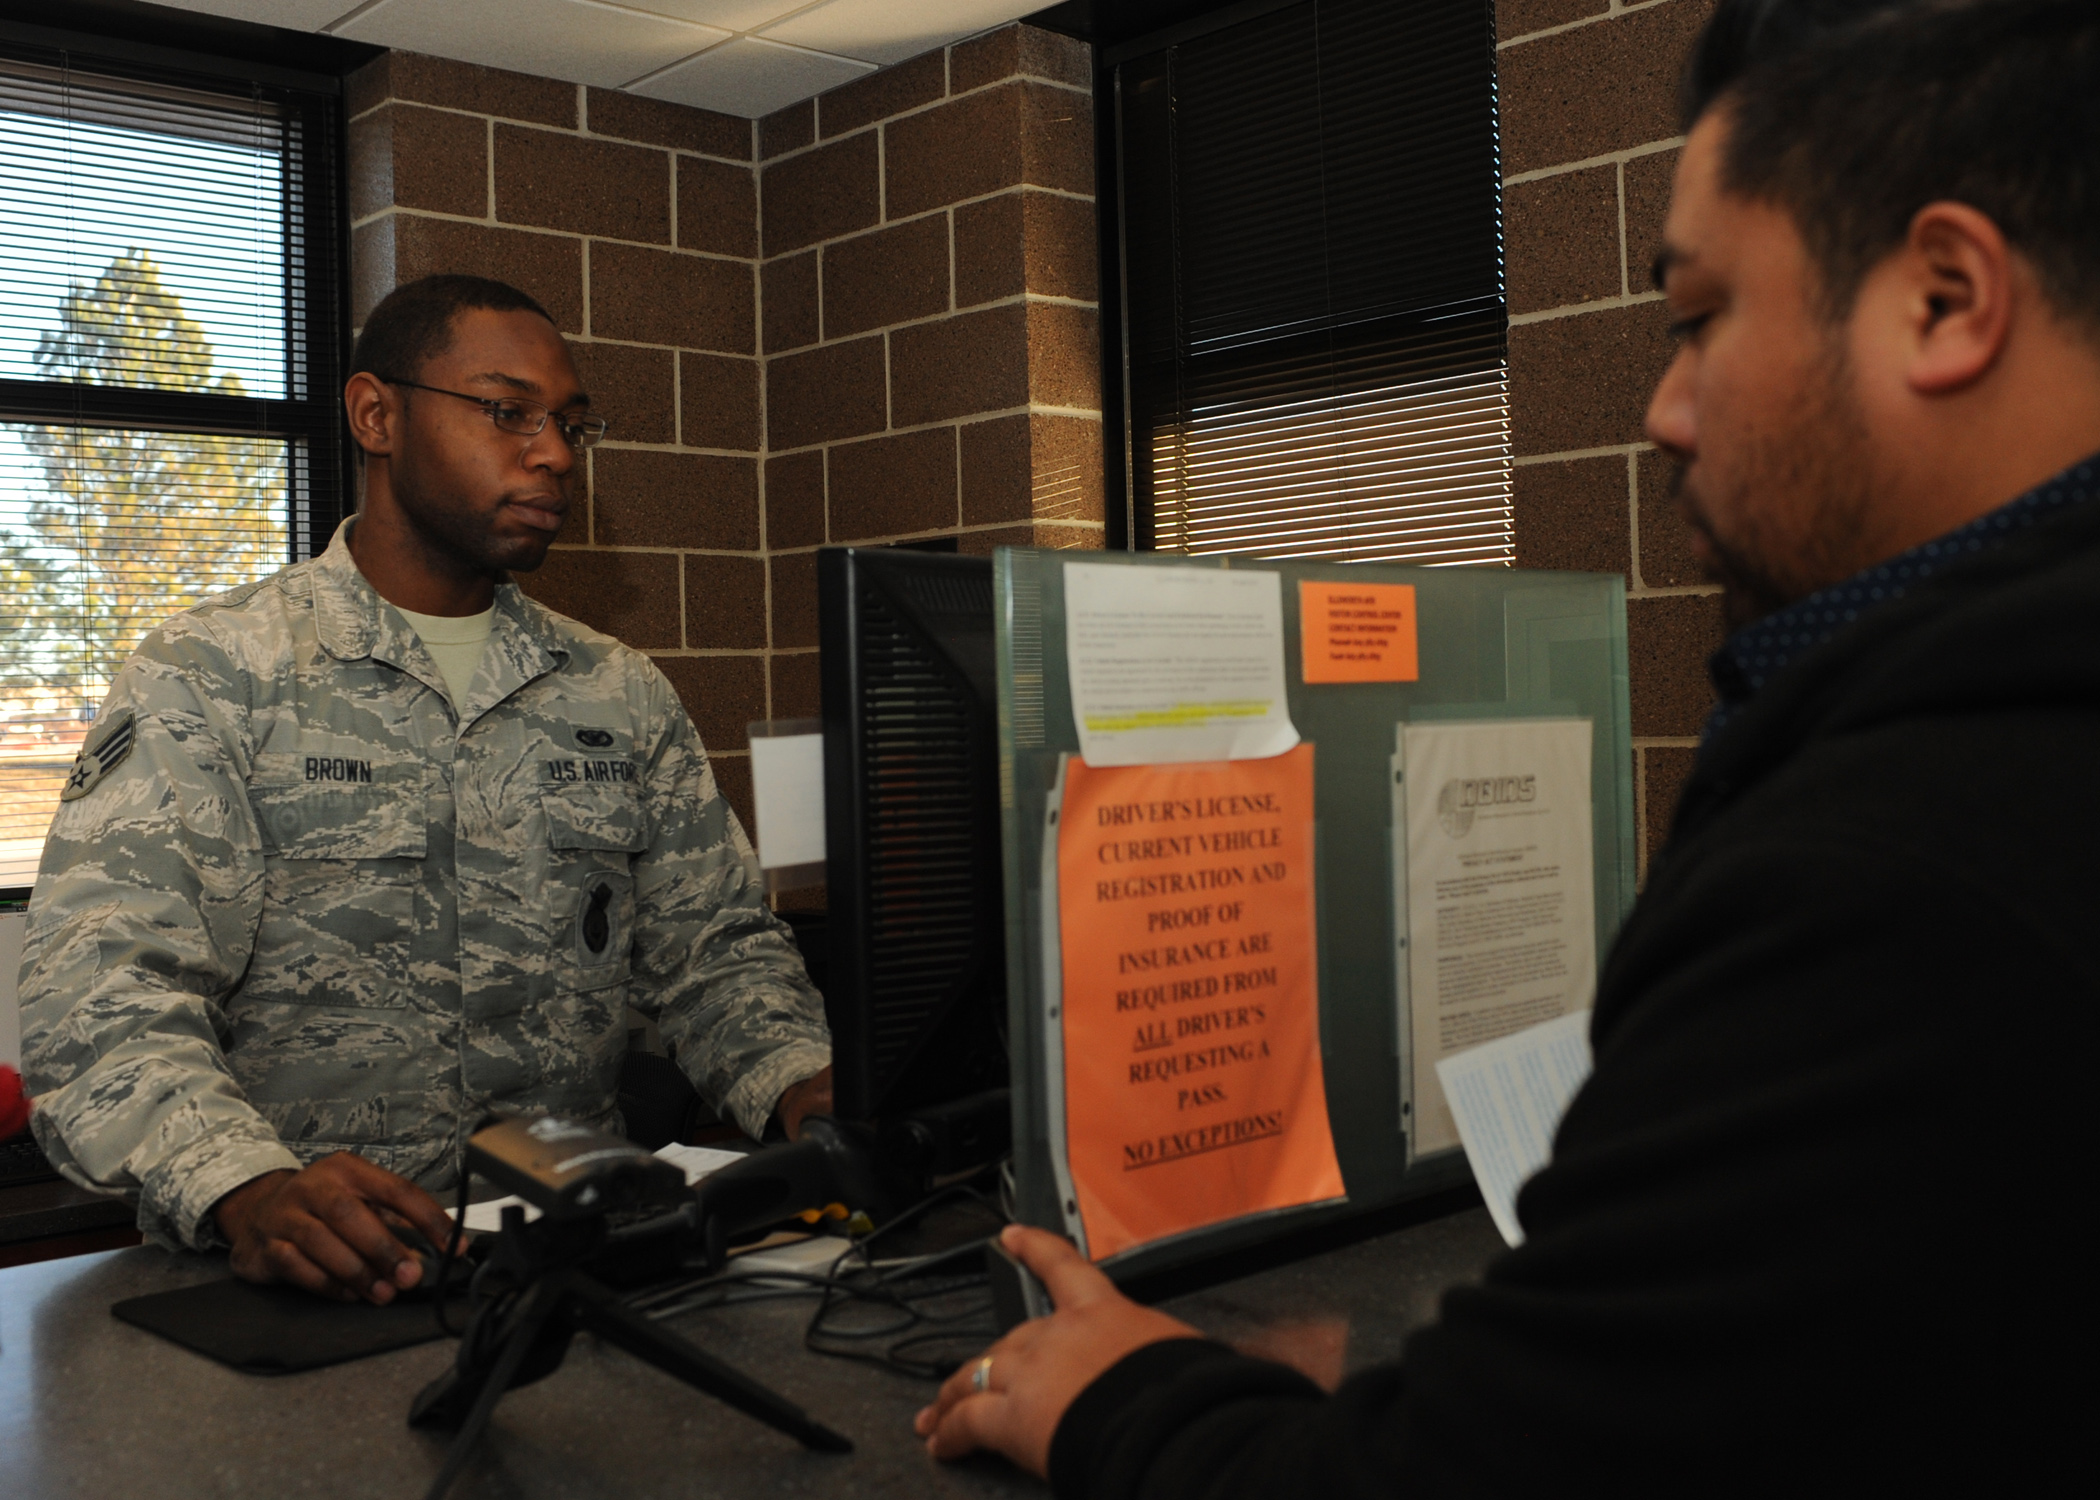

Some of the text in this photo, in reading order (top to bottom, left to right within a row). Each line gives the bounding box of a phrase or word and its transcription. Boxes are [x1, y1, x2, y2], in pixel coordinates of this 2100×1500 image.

[305, 757, 372, 783] BROWN
[549, 760, 581, 781] U.S.
[584, 760, 610, 781] AIR
[1098, 800, 1192, 827] DRIVER'S
[1098, 827, 1282, 865] CURRENT VEHICLE
[1096, 861, 1286, 903] REGISTRATION AND
[1147, 901, 1246, 933] PROOF OF
[1118, 932, 1273, 975] INSURANCE ARE
[1116, 967, 1278, 1013] REQUIRED FROM
[1133, 1004, 1267, 1051] ALL DRIVER'S
[1129, 1039, 1271, 1085] REQUESTING A
[1123, 1141, 1154, 1167] NO
